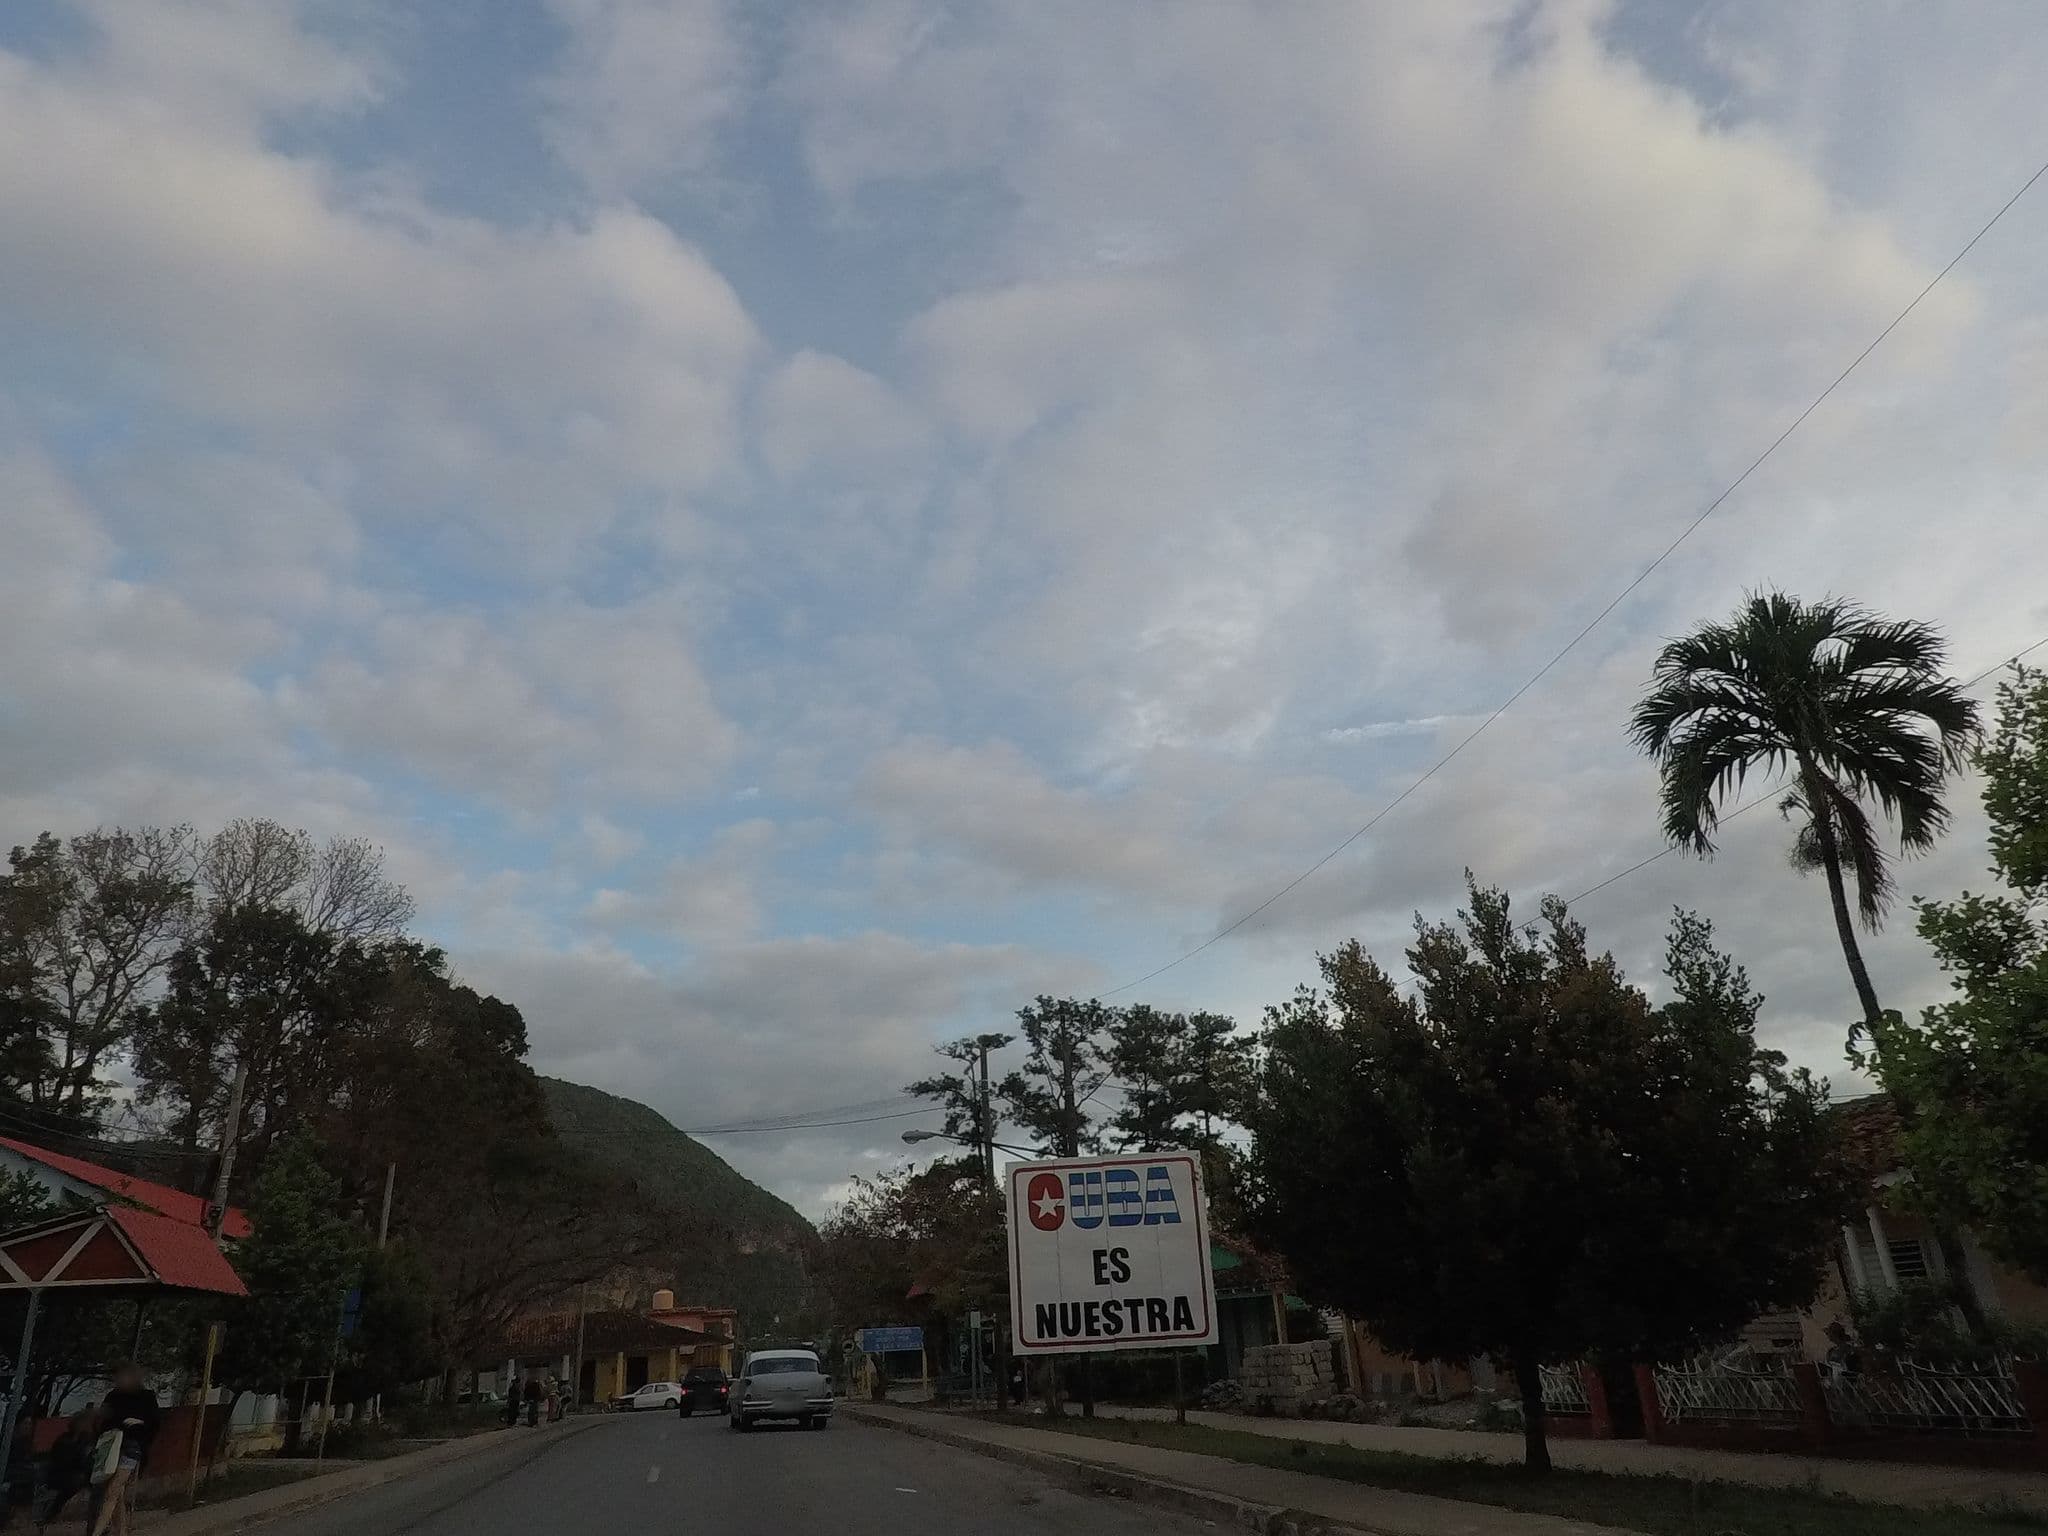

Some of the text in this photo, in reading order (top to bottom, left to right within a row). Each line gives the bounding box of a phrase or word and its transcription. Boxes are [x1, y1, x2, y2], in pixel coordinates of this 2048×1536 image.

[1028, 1166, 1181, 1231] CUBA
[1092, 1247, 1131, 1285] ES
[1036, 1296, 1195, 1338] NUESTRA
